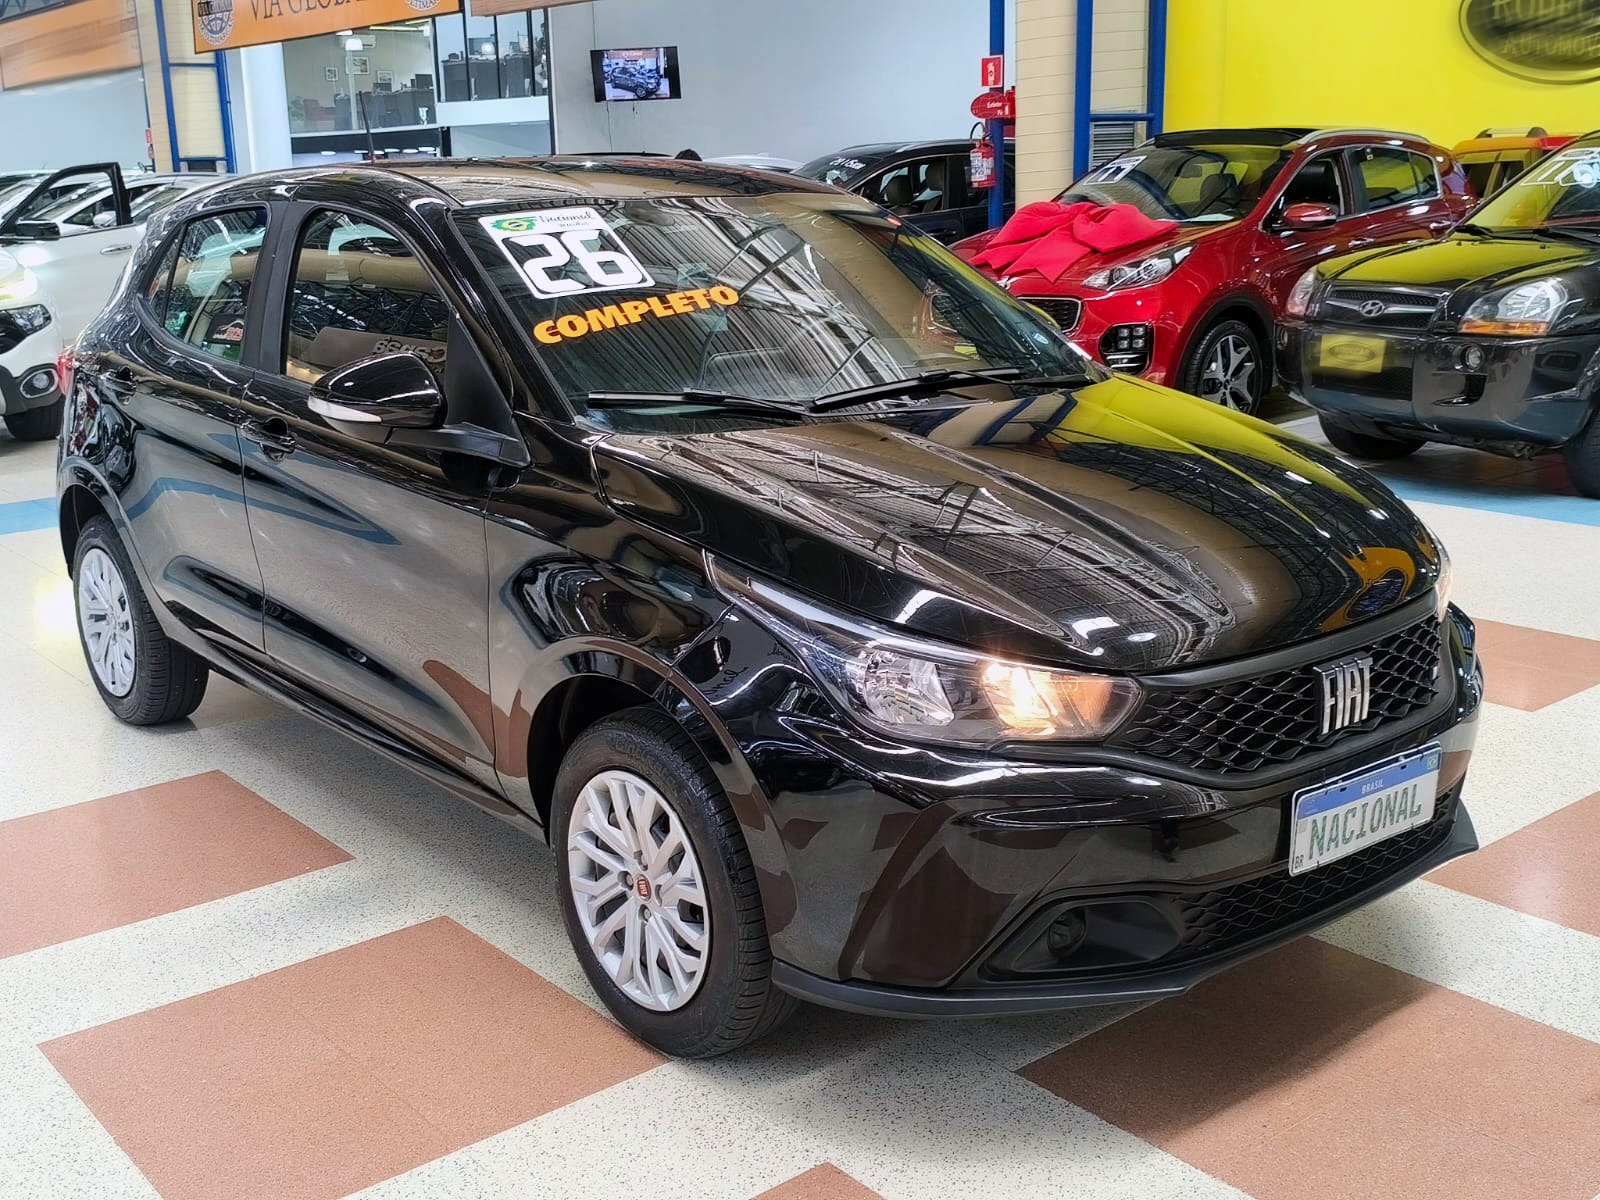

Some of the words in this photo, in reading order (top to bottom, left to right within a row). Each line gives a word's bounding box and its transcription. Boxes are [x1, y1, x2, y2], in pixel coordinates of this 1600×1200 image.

[509, 229, 645, 293] 26
[533, 283, 739, 344] COMPLETO
[1322, 657, 1374, 735] FIAT
[1361, 779, 1384, 794] BRASIL
[1308, 784, 1422, 860] NACIONAL
[1294, 854, 1305, 869] BR
